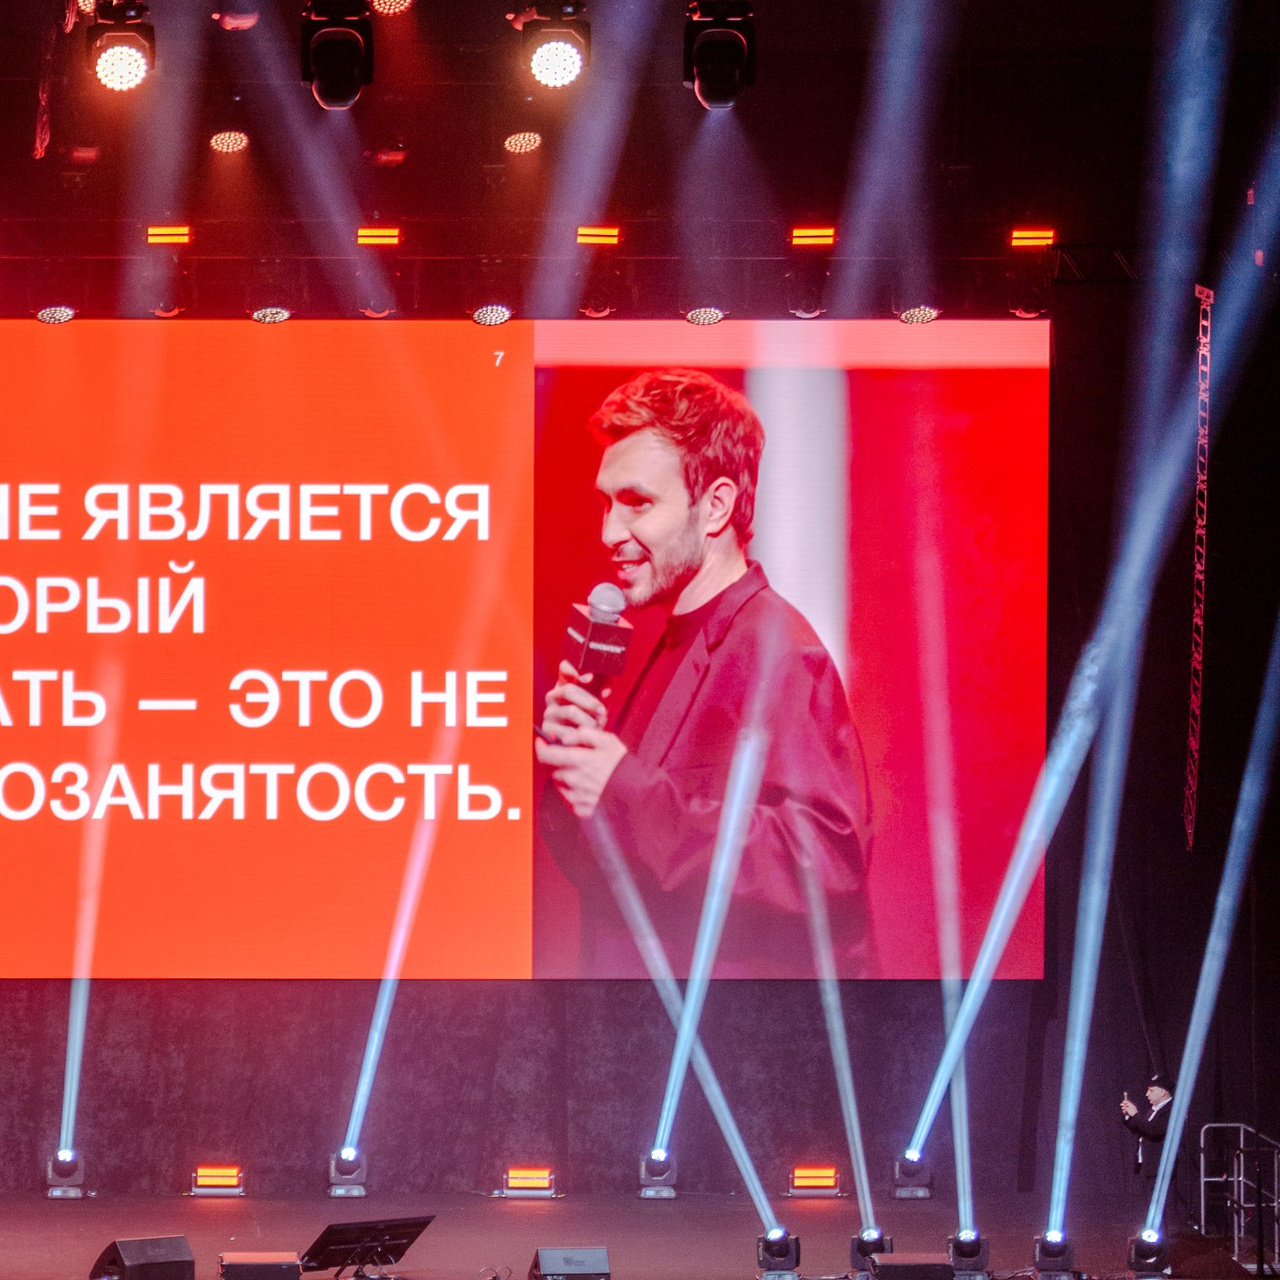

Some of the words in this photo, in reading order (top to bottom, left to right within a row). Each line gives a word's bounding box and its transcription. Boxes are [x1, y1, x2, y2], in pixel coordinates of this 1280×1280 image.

[493, 351, 504, 367] 7
[82, 482, 490, 542] ЯВЛЯЕТСЯ
[229, 669, 384, 729] ЭТО
[410, 670, 509, 728] НЕ
